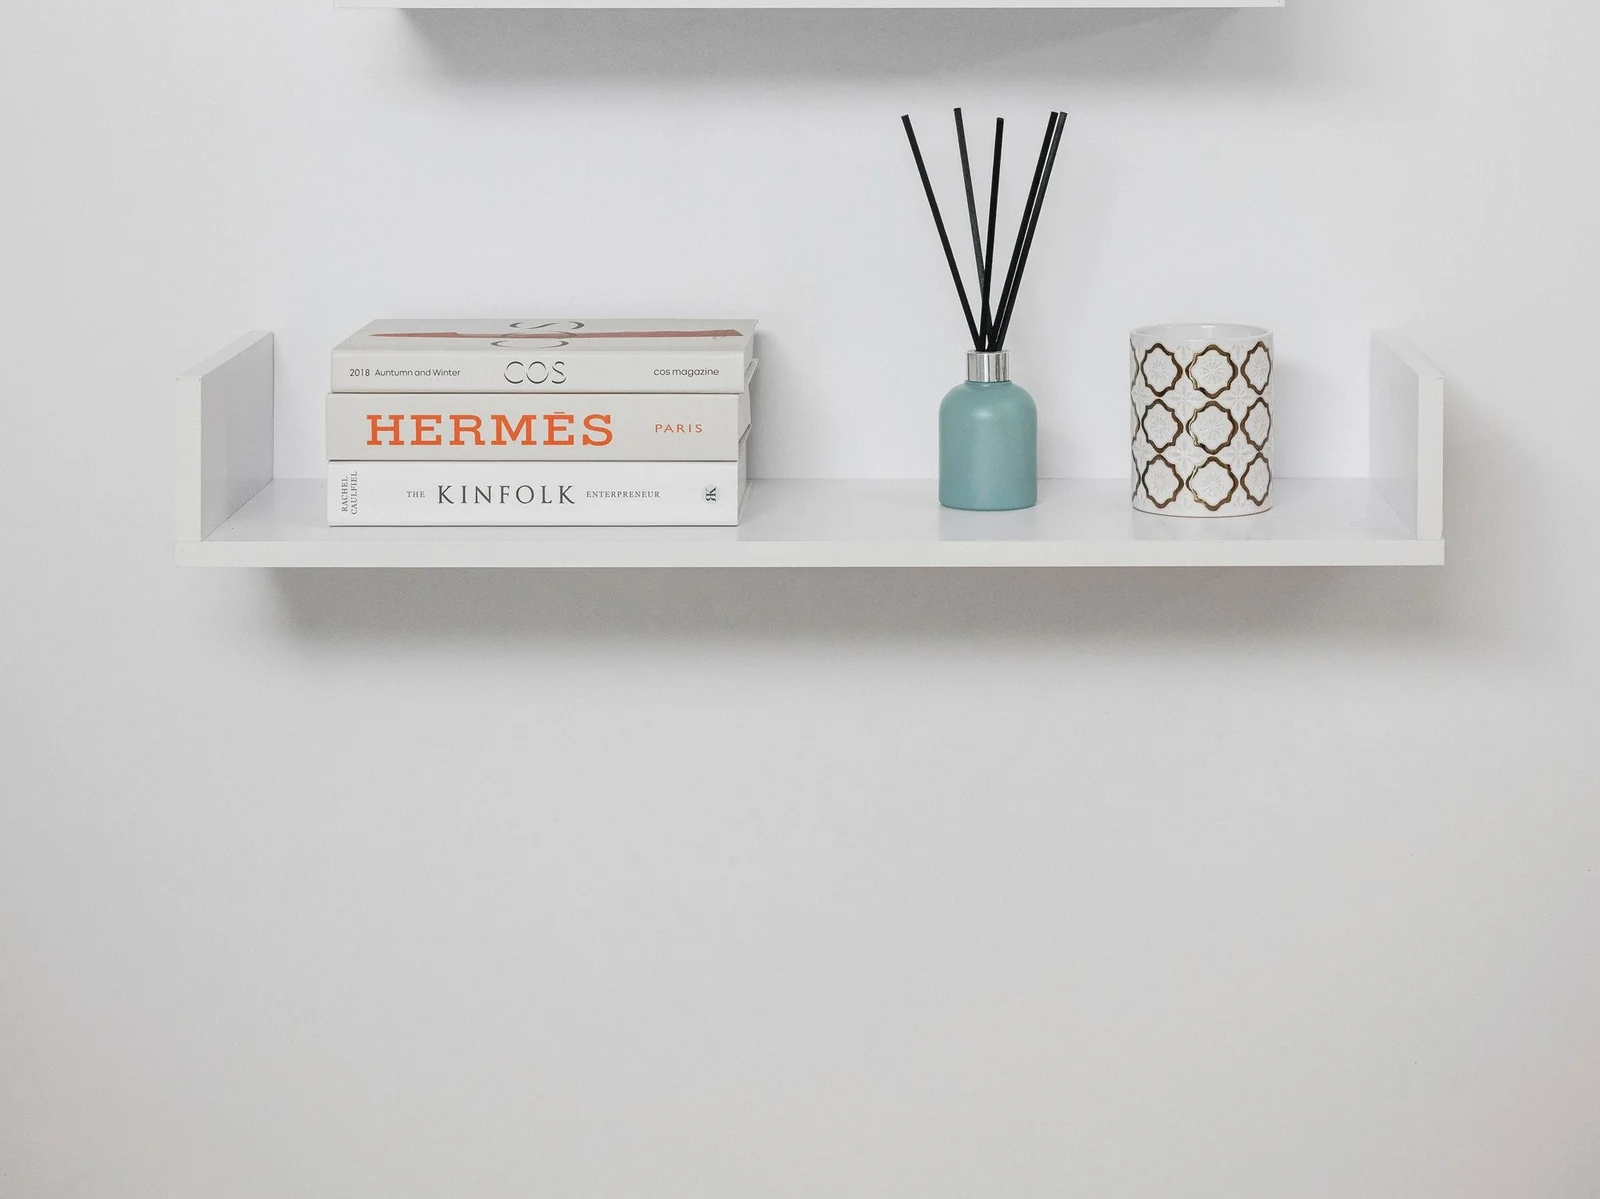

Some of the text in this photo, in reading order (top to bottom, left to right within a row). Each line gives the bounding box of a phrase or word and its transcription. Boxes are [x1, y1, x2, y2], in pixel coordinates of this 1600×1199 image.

[349, 368, 461, 377] 2018 Auntumn and Winter
[503, 361, 567, 385] COS
[653, 367, 720, 378] cos magazine
[655, 423, 703, 433] PARIS
[341, 475, 349, 513] RACHEL
[406, 485, 660, 504] THE KINFOLK ENTERPRENEUR
